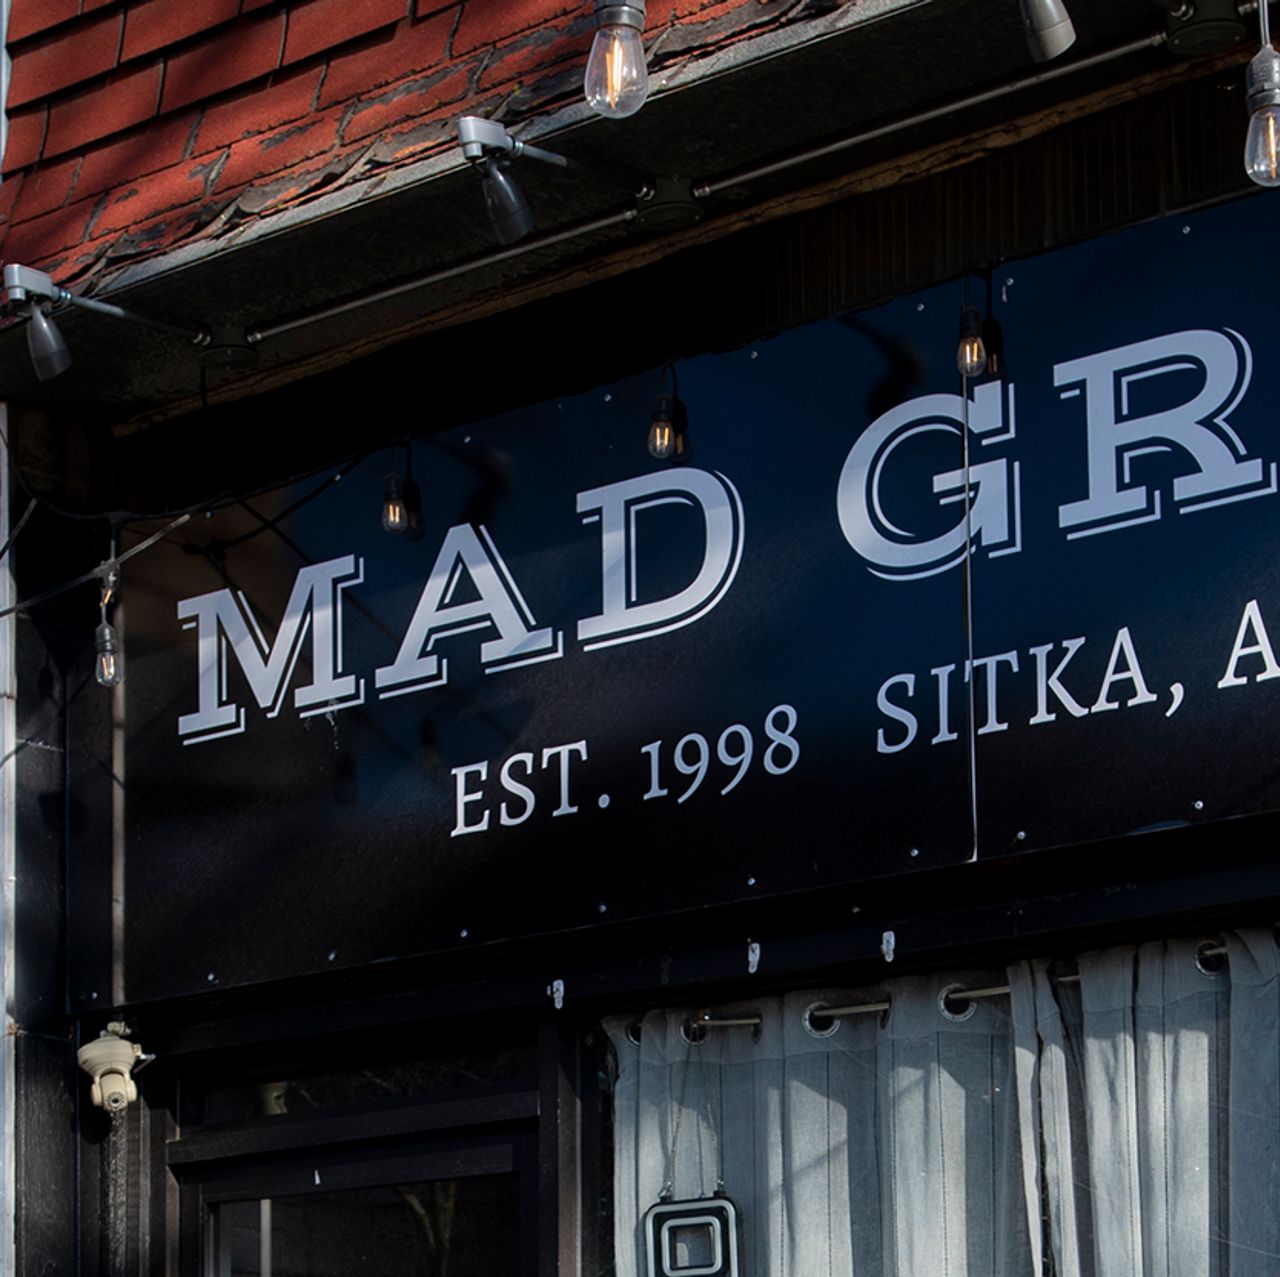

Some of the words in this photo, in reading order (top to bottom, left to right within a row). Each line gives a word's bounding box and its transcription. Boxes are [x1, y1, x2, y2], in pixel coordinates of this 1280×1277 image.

[177, 466, 745, 746] MAD
[450, 741, 610, 838] EST.
[642, 704, 801, 804] 1998
[875, 625, 1186, 756] SITKA,
